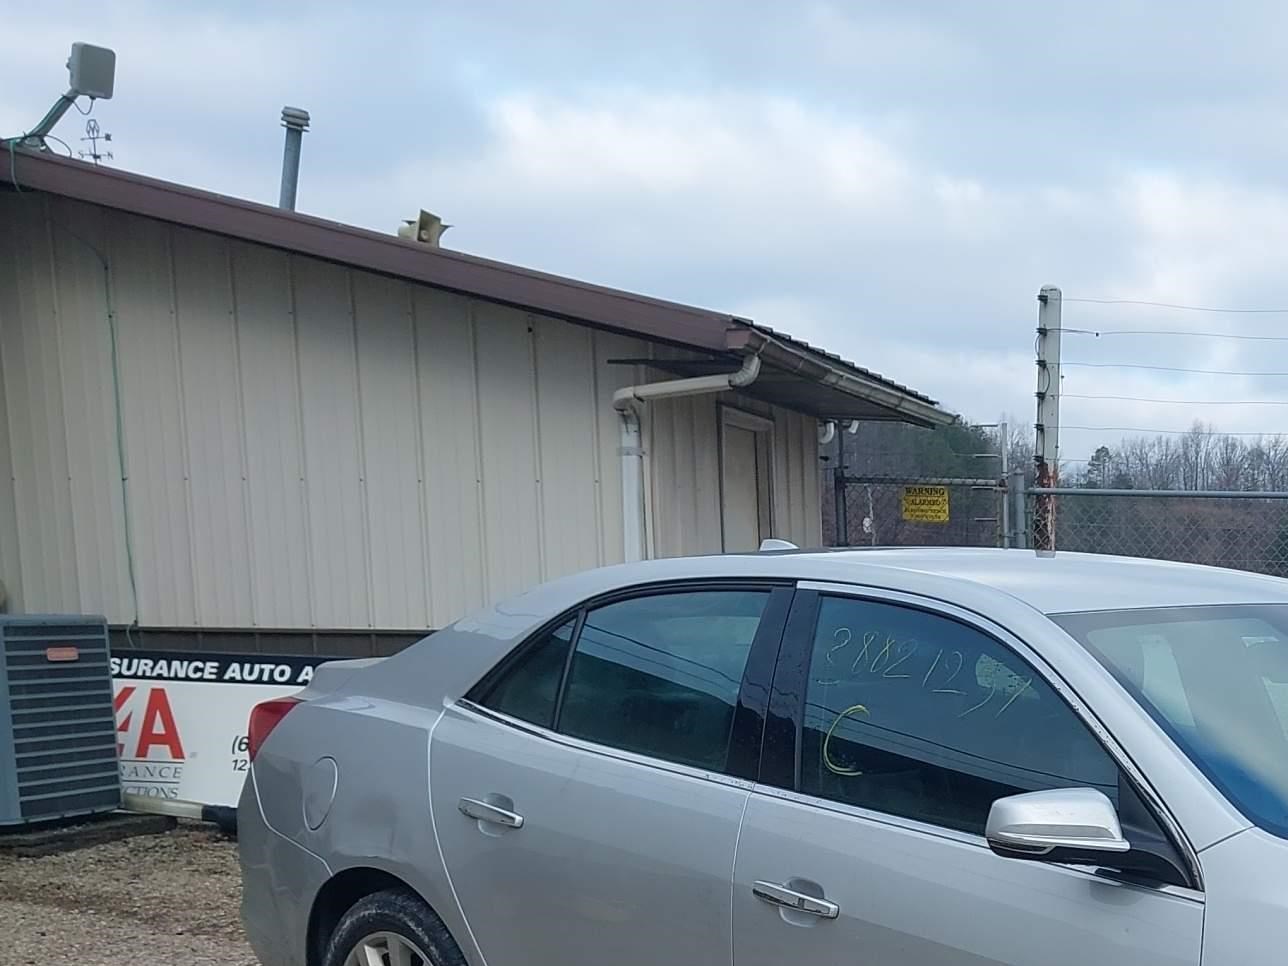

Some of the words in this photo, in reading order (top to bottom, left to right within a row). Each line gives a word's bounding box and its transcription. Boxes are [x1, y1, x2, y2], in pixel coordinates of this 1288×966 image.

[905, 487, 945, 496] WARNING
[111, 657, 219, 679] SURANCE
[223, 663, 292, 682] AUTO
